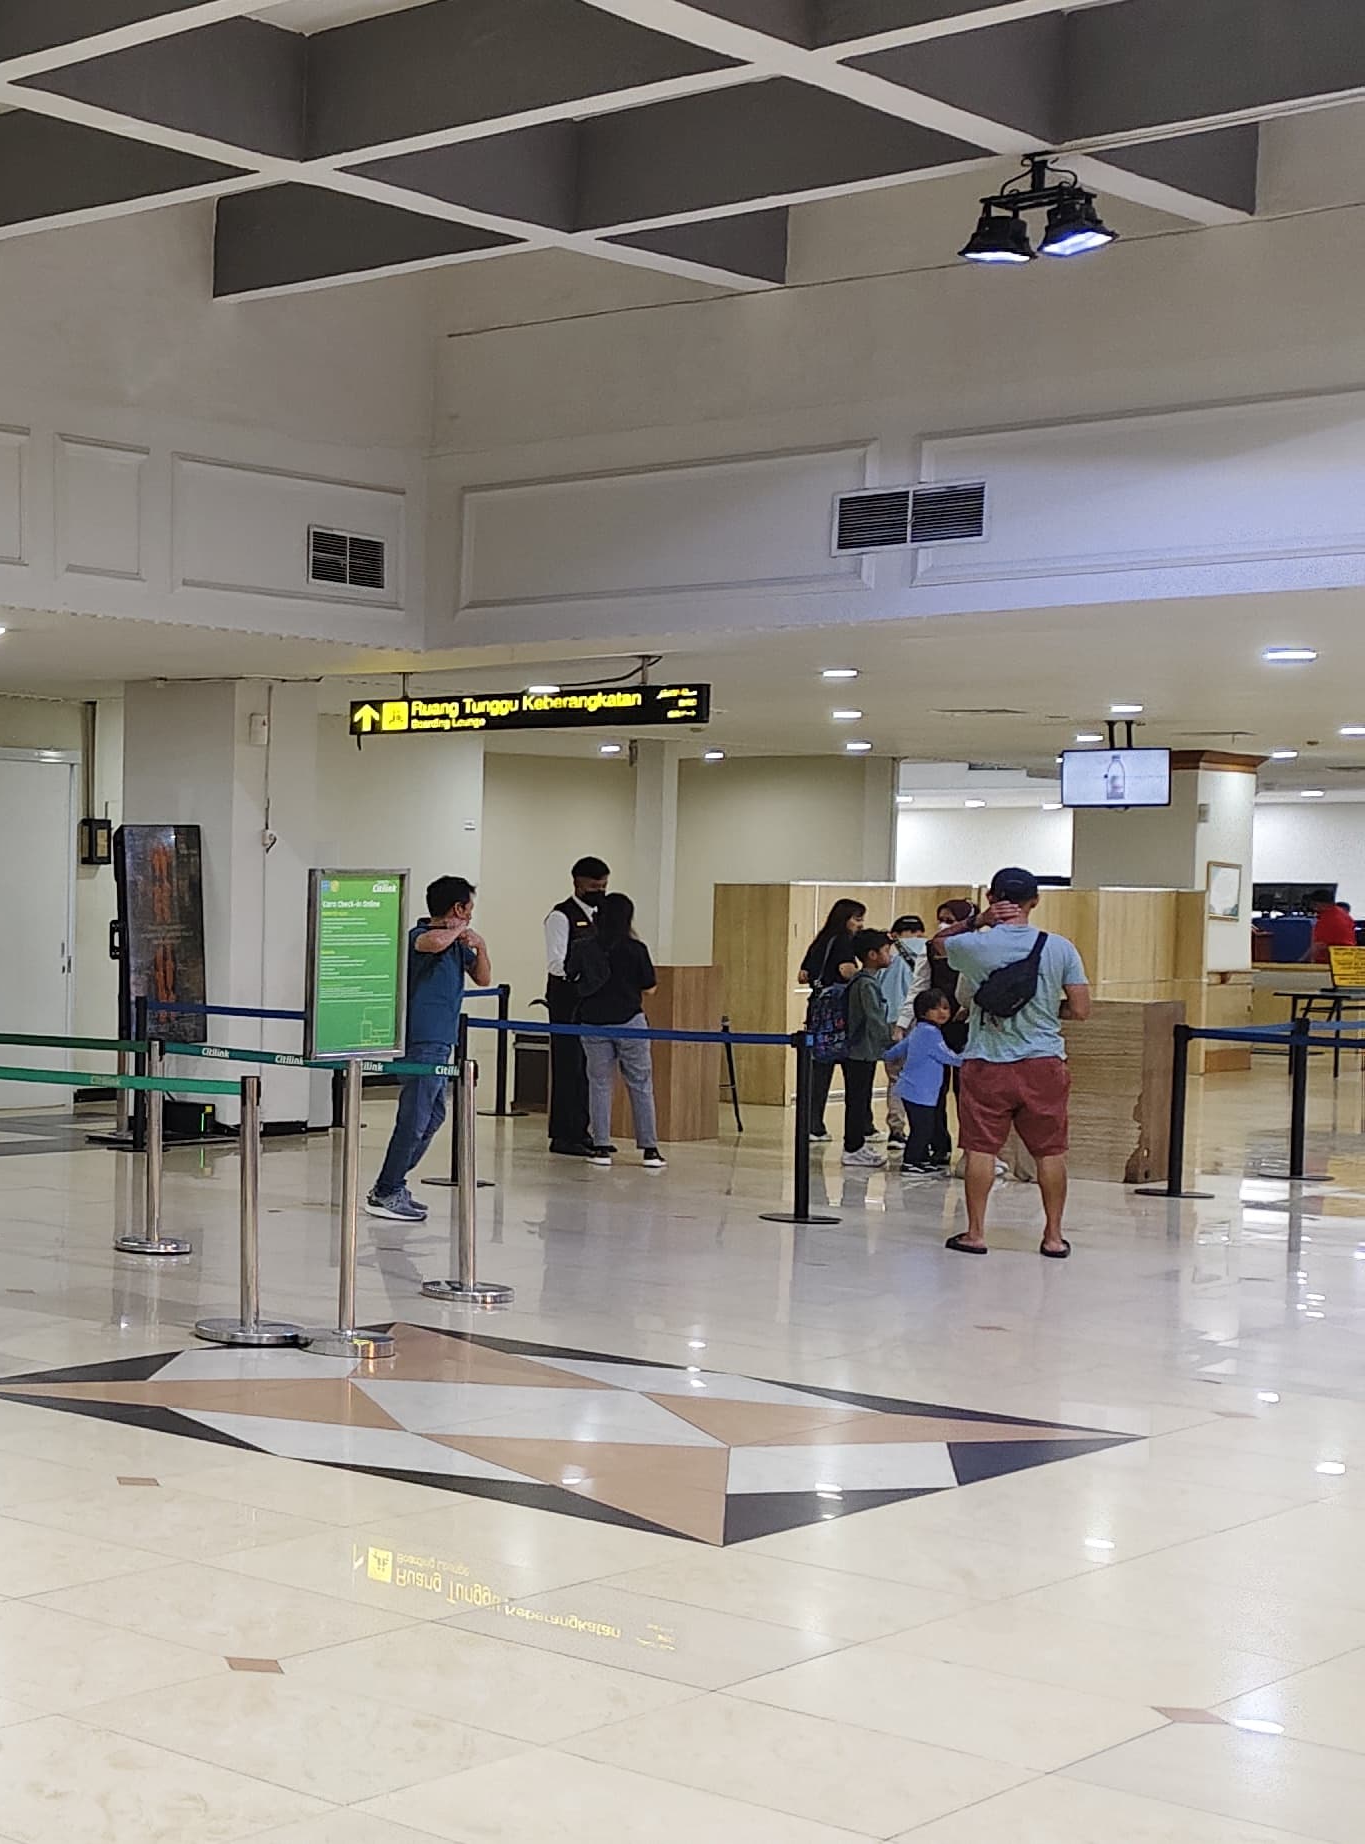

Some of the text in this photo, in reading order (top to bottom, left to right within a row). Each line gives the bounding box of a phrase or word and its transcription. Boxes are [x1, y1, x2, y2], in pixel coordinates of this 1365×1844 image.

[411, 701, 459, 718] Ruang
[462, 698, 519, 716] Tunggu
[522, 691, 642, 713] Keberangkatan
[201, 1046, 229, 1058] Citilink
[274, 1054, 305, 1066] Citilink
